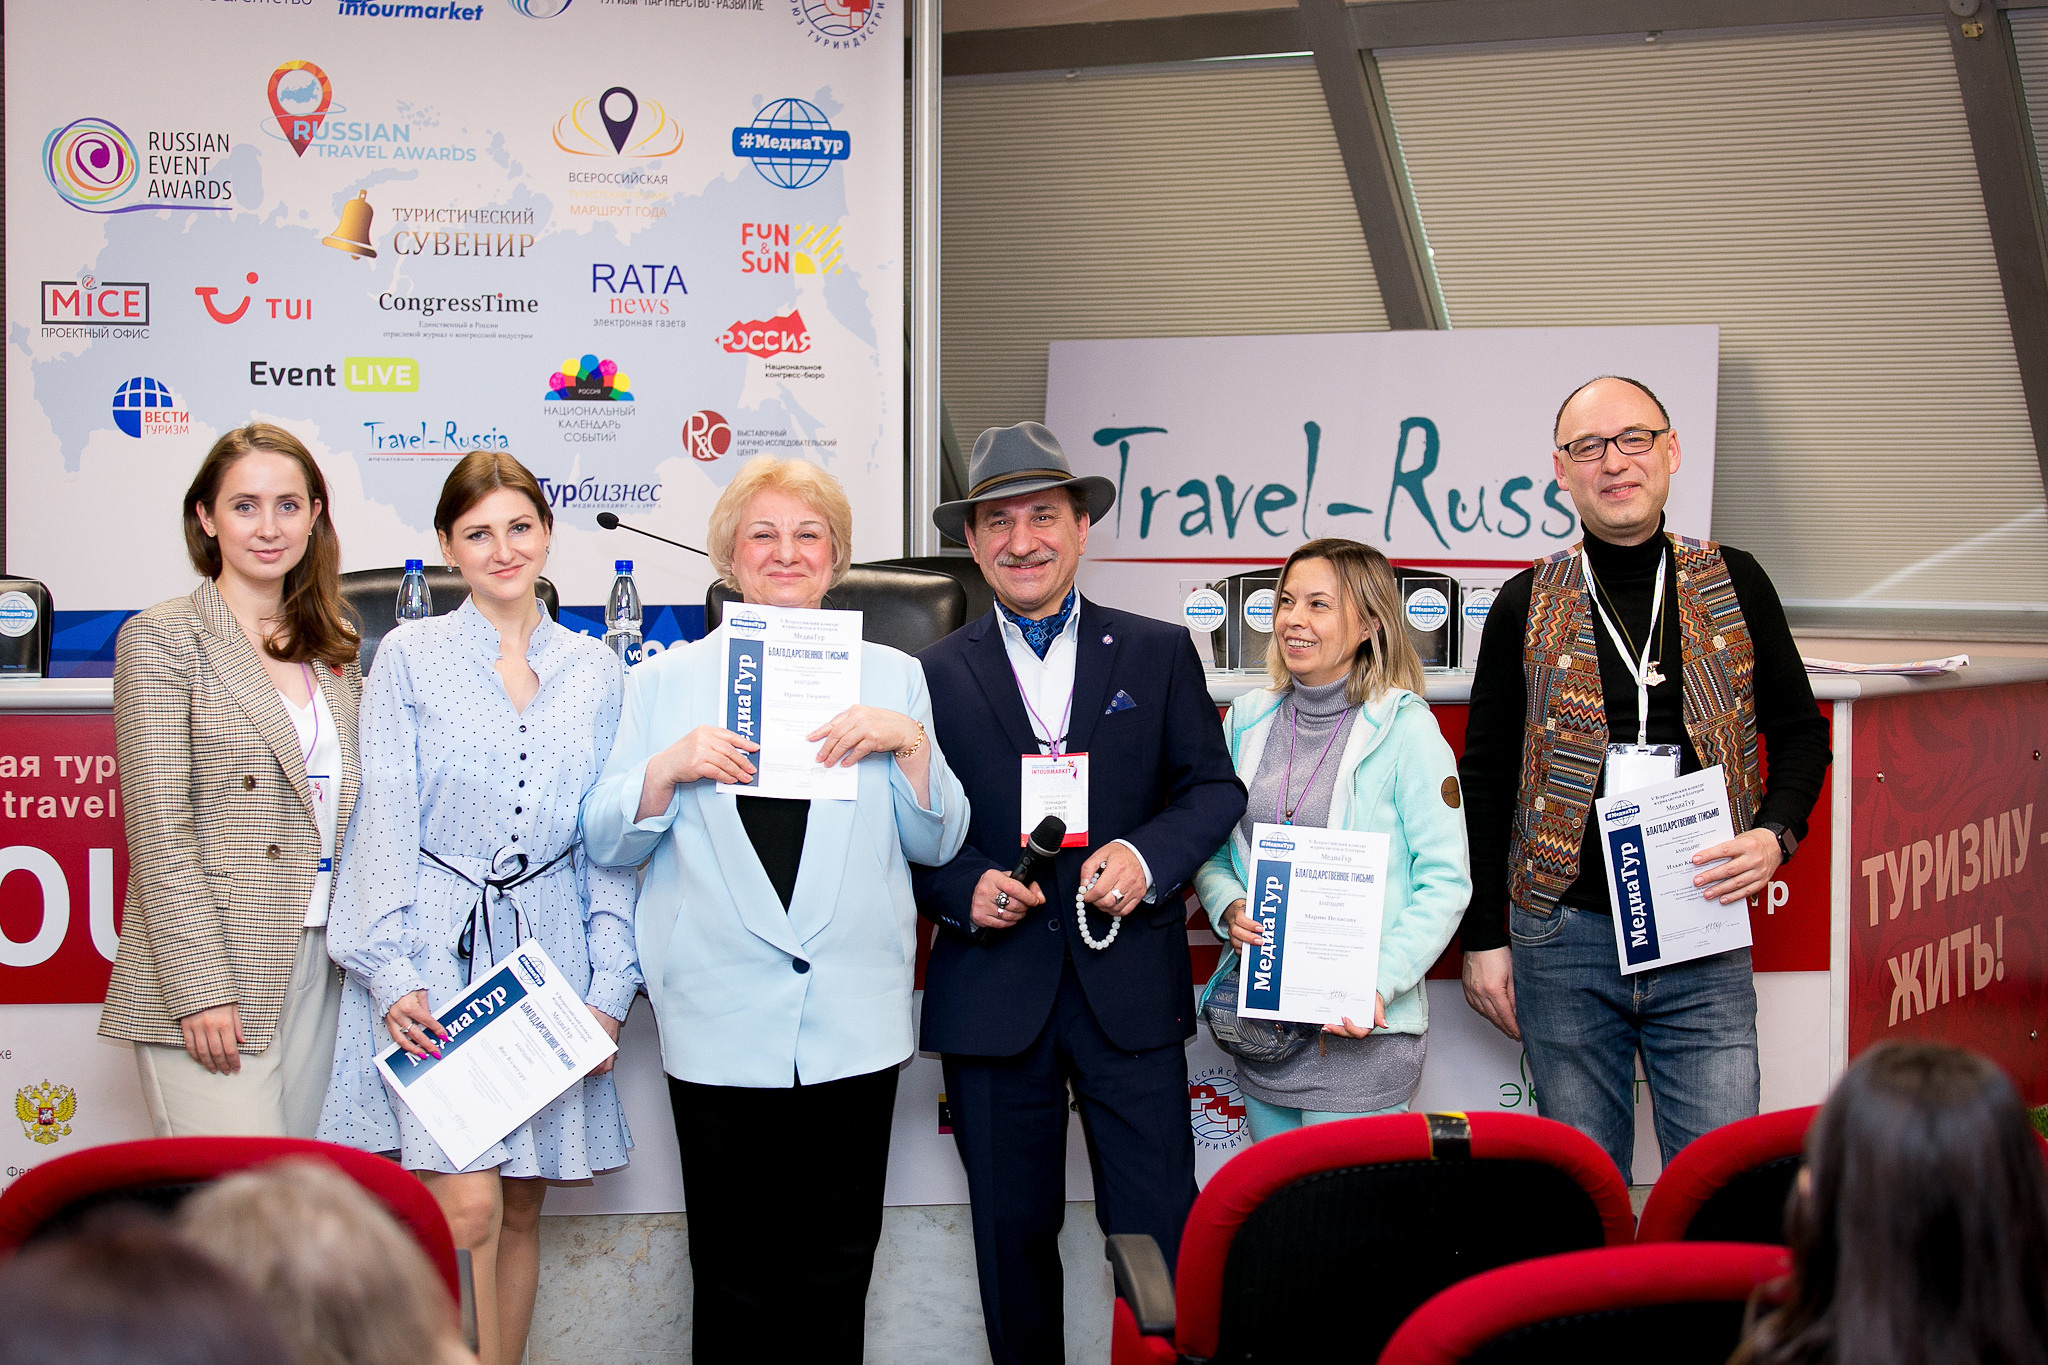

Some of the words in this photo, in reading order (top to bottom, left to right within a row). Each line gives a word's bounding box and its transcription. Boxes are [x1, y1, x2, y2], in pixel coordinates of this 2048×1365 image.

[293, 120, 411, 143] RUSSIAN
[149, 132, 230, 153] RUSSIAN
[317, 143, 387, 159] TRAVEL
[392, 146, 477, 162] AWARDS
[739, 132, 845, 155] #МедиаТур
[149, 156, 210, 176] EVENT
[568, 172, 669, 185] ВСЕРОССИЙСКАЯ
[148, 179, 232, 200] AWARDS
[392, 206, 535, 225] ТУРИСТИЧЕСКИЙ
[570, 204, 631, 217] МАРШРУТ
[635, 206, 668, 219] ГОДА
[393, 230, 536, 258] СУВЕНИР
[742, 223, 789, 246] FUN
[742, 251, 789, 273] SUN
[592, 263, 689, 295] RATA
[266, 298, 312, 320] TUI
[379, 292, 539, 317] CongressTime
[609, 296, 671, 315] news
[41, 325, 109, 339] ПРОЕКТНЫЙ
[113, 328, 150, 340] ОФИС
[593, 318, 653, 328] электронная
[655, 319, 687, 328] газета
[719, 330, 812, 352] РОССИЯ
[250, 360, 336, 387] Event
[350, 364, 412, 387] LIVE
[765, 363, 822, 371] Национальное
[144, 411, 190, 424] ВЕСТИ
[544, 405, 636, 417] НАЦИОНАЛЬНЫЙ
[144, 425, 190, 436] ТУРИЗМ
[363, 420, 510, 450] Travel-Russia
[558, 419, 621, 430] КАЛЕНДАРЬ
[564, 430, 617, 443] СОБЫТИЙ
[535, 476, 663, 508] Турбизнес
[0, 610, 33, 618] МедиаТур
[768, 647, 824, 660] БЛАГОДАРСТВЕННОЕ
[733, 654, 758, 759] диаТур
[1645, 814, 1698, 837] БЛАГОДАРСТВЕННОЕ
[1295, 867, 1349, 882] БЛАГОДАРСТВЕННОЕ
[1861, 803, 2034, 928] ТУРИЗМУ
[1620, 842, 1649, 949] МедиаТур
[1253, 875, 1284, 992] МедиаТур
[1887, 915, 2005, 1028] ЖИТЬ!
[520, 1001, 561, 1051] БЛАГОДАРСТВЕННОЕ
